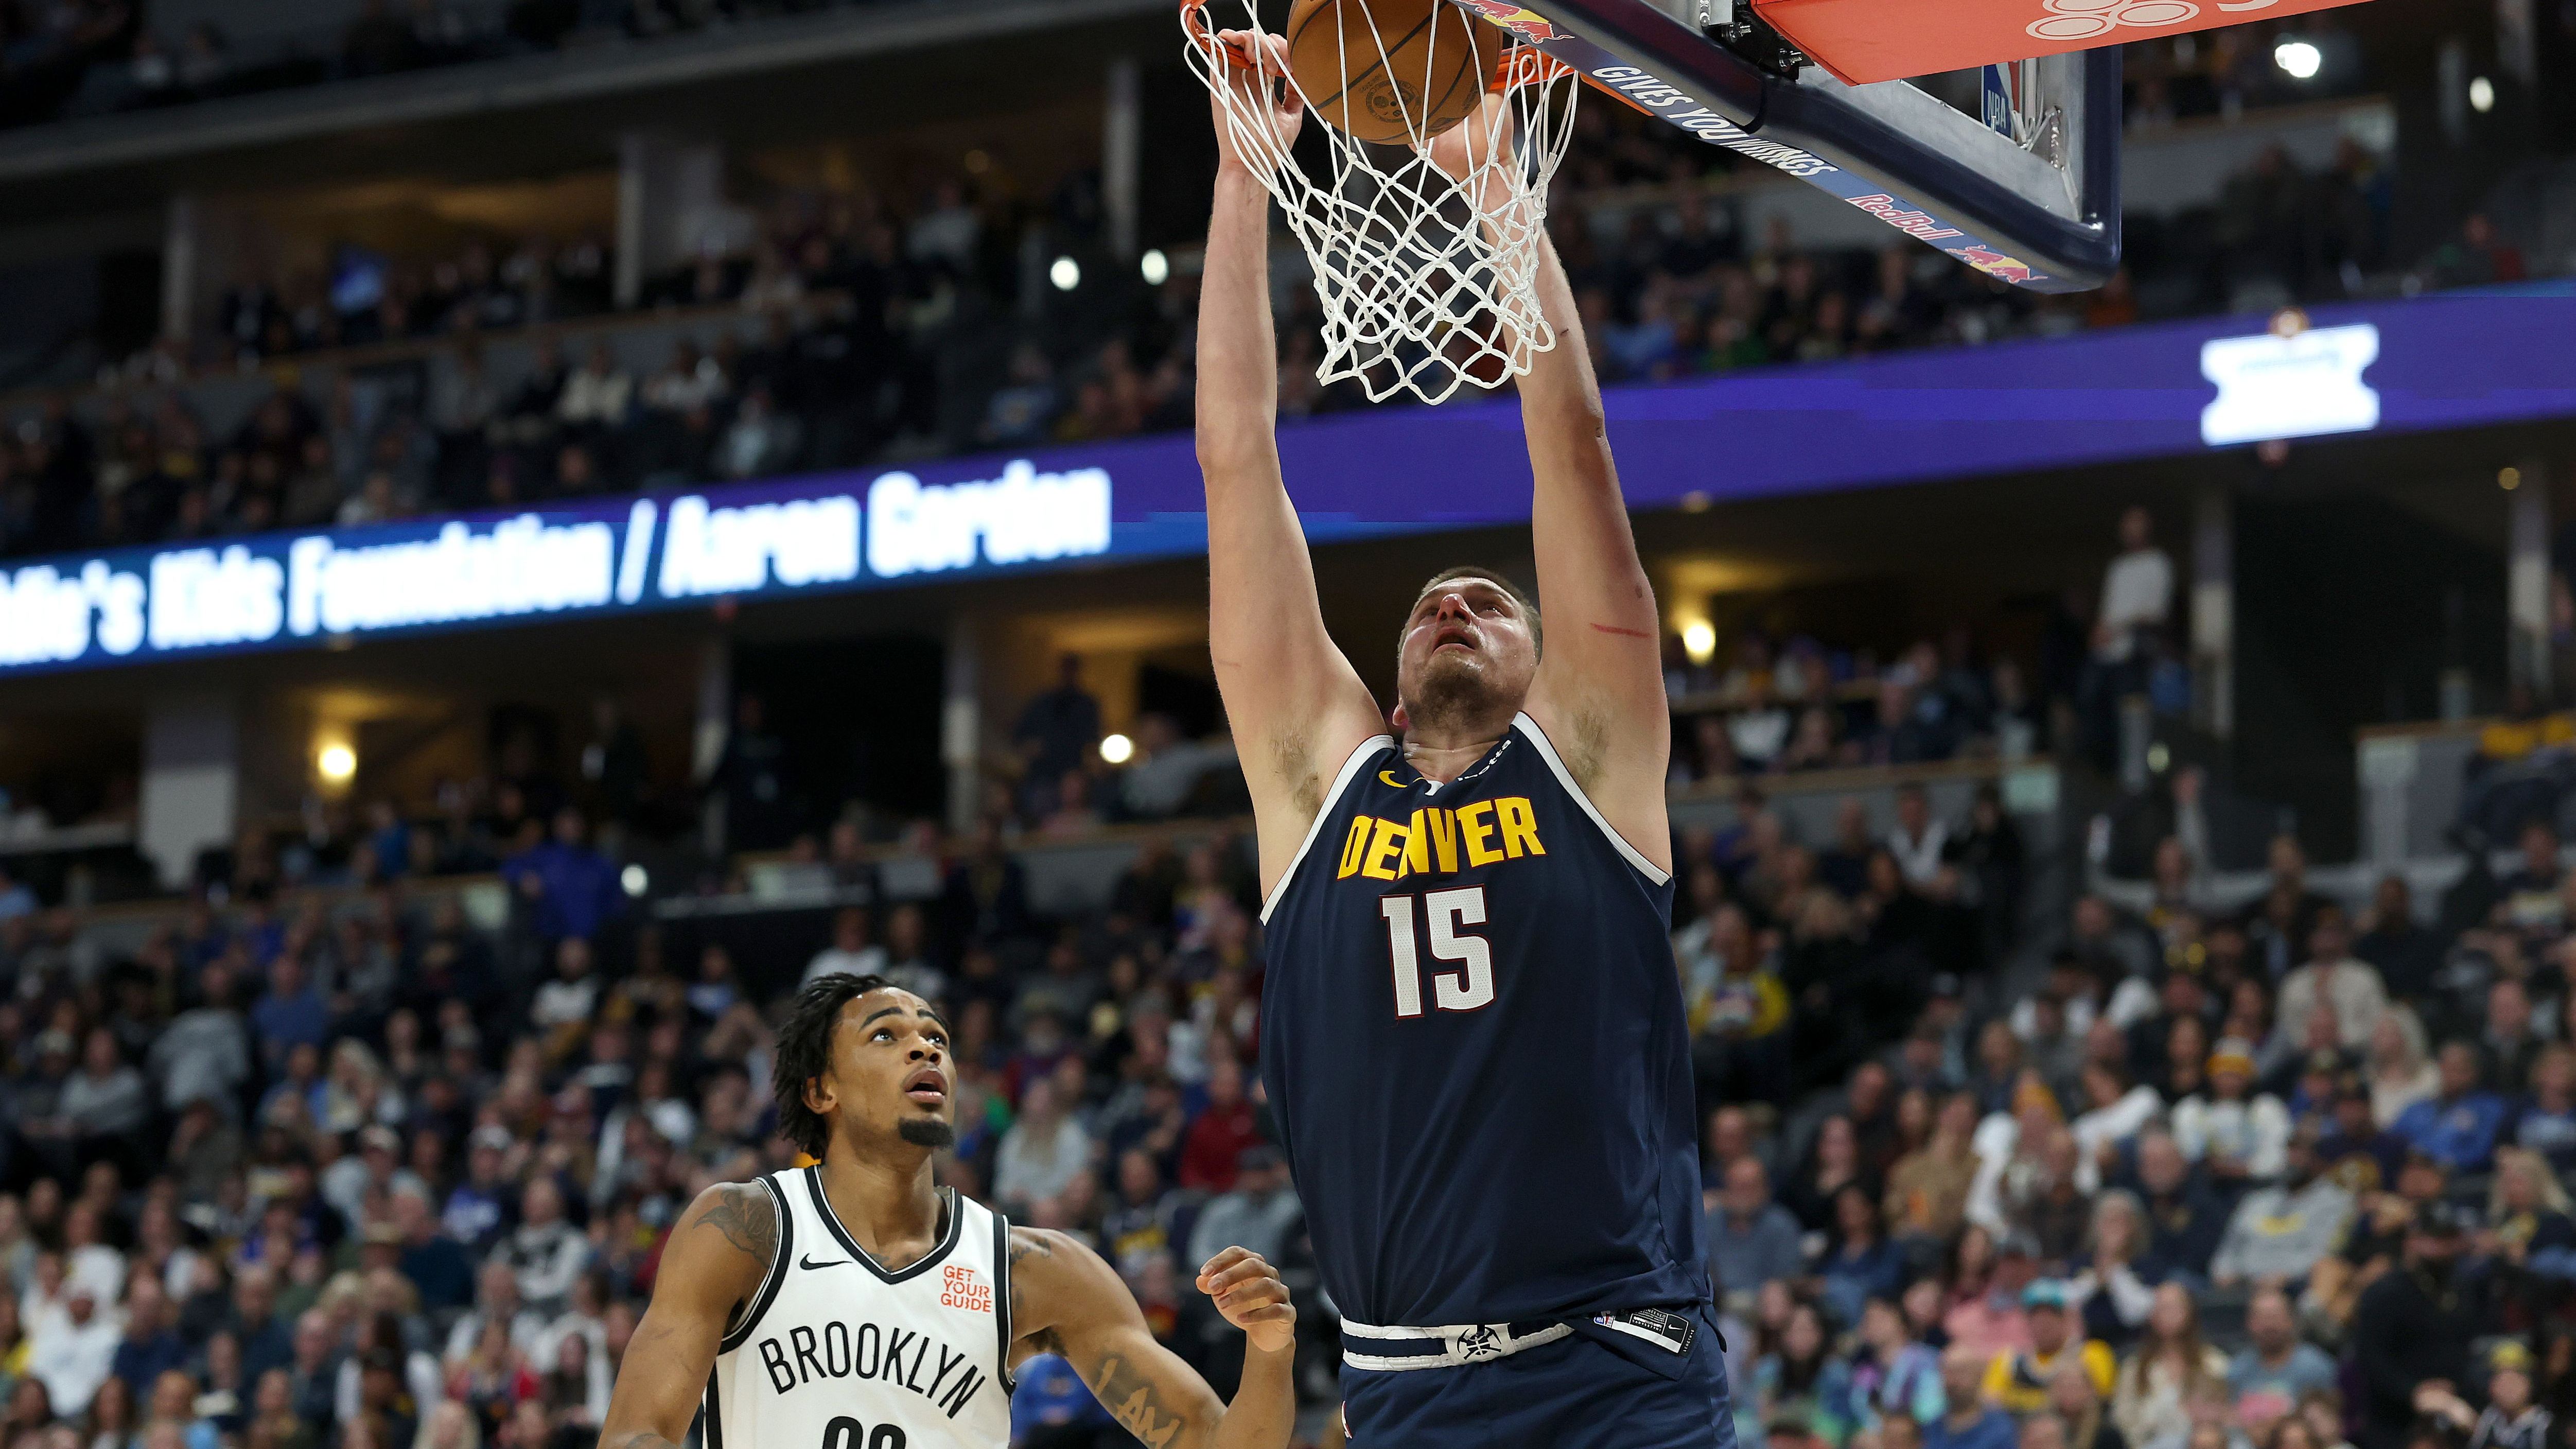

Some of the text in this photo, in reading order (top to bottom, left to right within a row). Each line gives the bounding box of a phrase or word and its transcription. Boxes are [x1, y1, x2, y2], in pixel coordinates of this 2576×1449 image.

[1592, 66, 1694, 107] GIVES
[1667, 107, 1750, 139] YOU
[1987, 90, 2006, 129] NBA
[289, 515, 612, 634] Foundation
[619, 502, 656, 601] /
[660, 497, 859, 596] Aaron
[868, 461, 1111, 575] Gordon
[1337, 796, 1547, 881] DENVER
[1379, 884, 1497, 1019] 15
[940, 1293, 992, 1313] GUIDE
[943, 1278, 990, 1298] YOUR
[944, 1265, 975, 1282] GET
[758, 1321, 986, 1420] BROOKLYN
